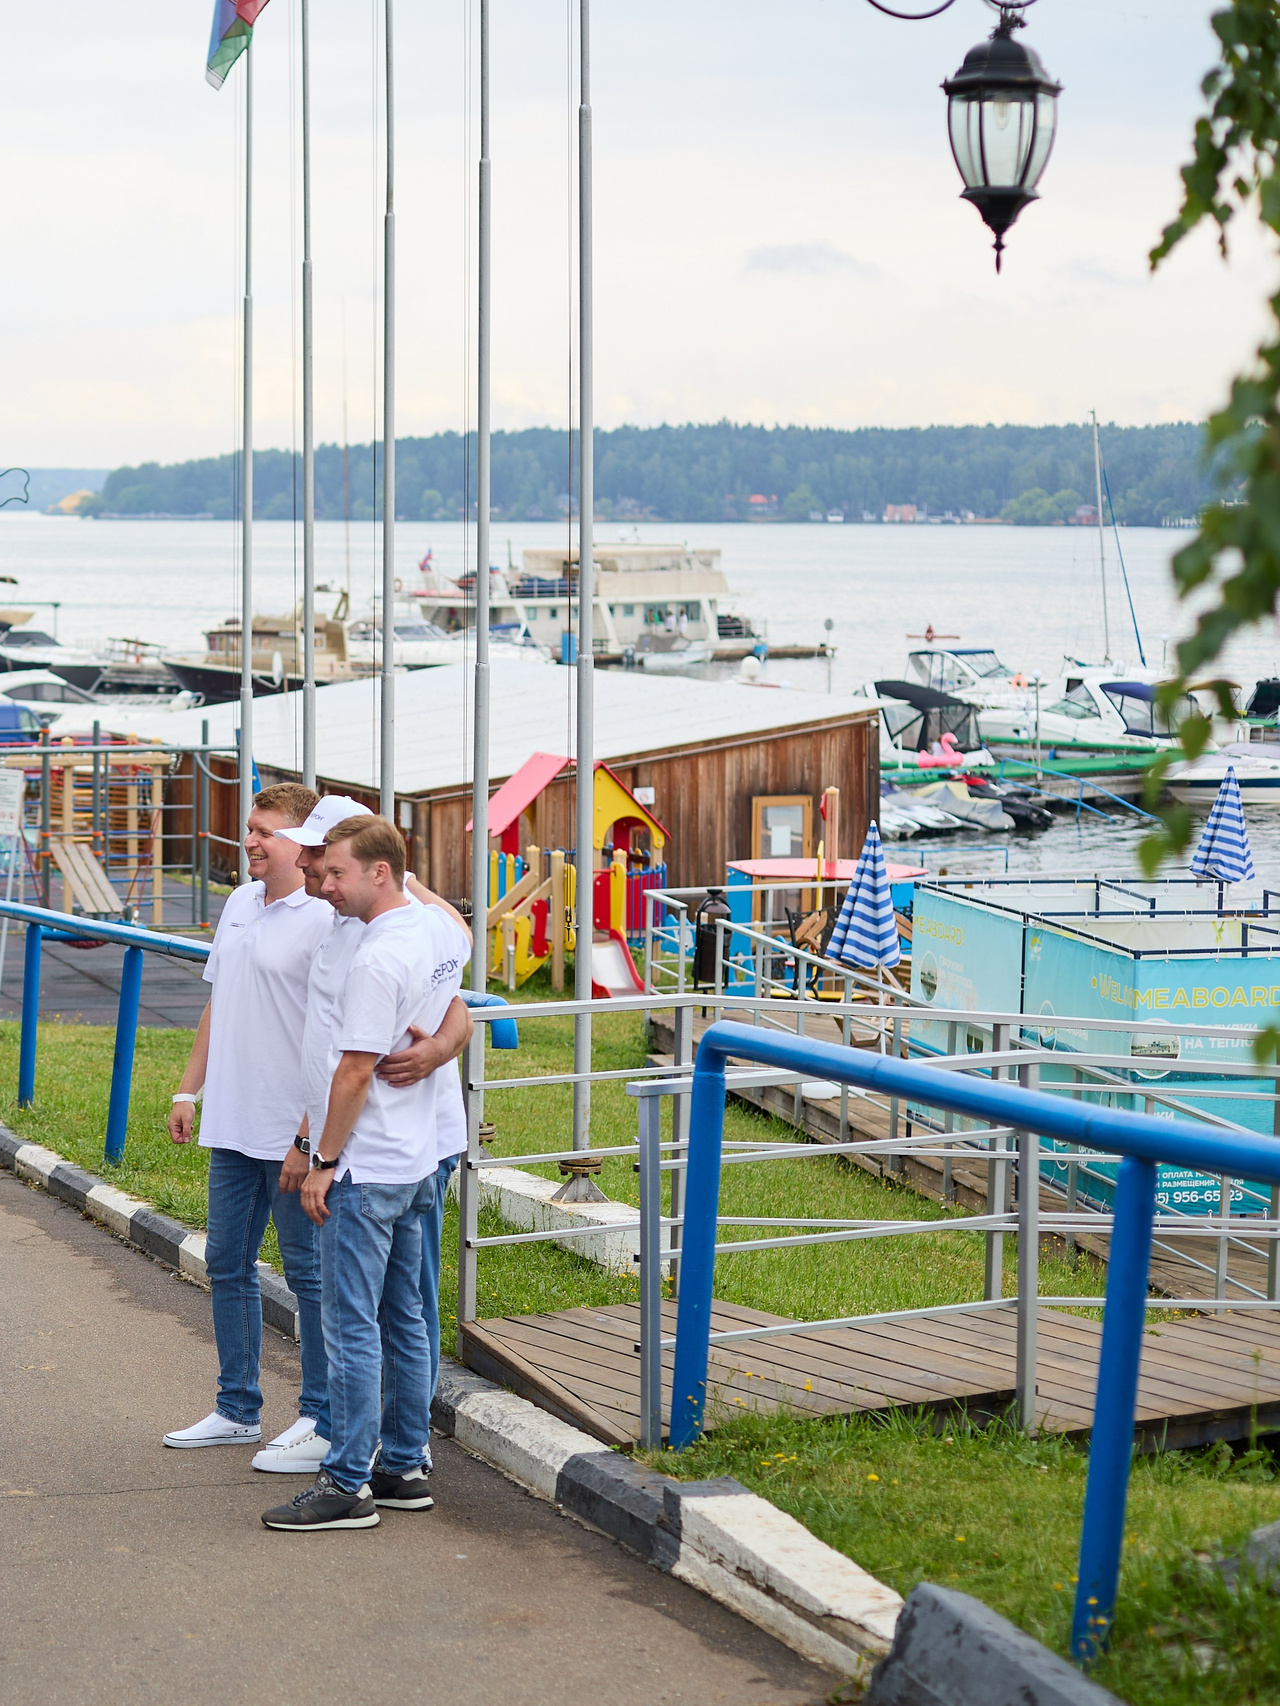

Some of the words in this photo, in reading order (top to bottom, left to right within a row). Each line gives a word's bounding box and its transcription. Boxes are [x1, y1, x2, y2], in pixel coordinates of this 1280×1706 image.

[1184, 1038, 1204, 1049] НА
[1162, 1170, 1193, 1179] ОПЛАТА
[1162, 1179, 1215, 1189] РАЗМЕЩЕНИЯ
